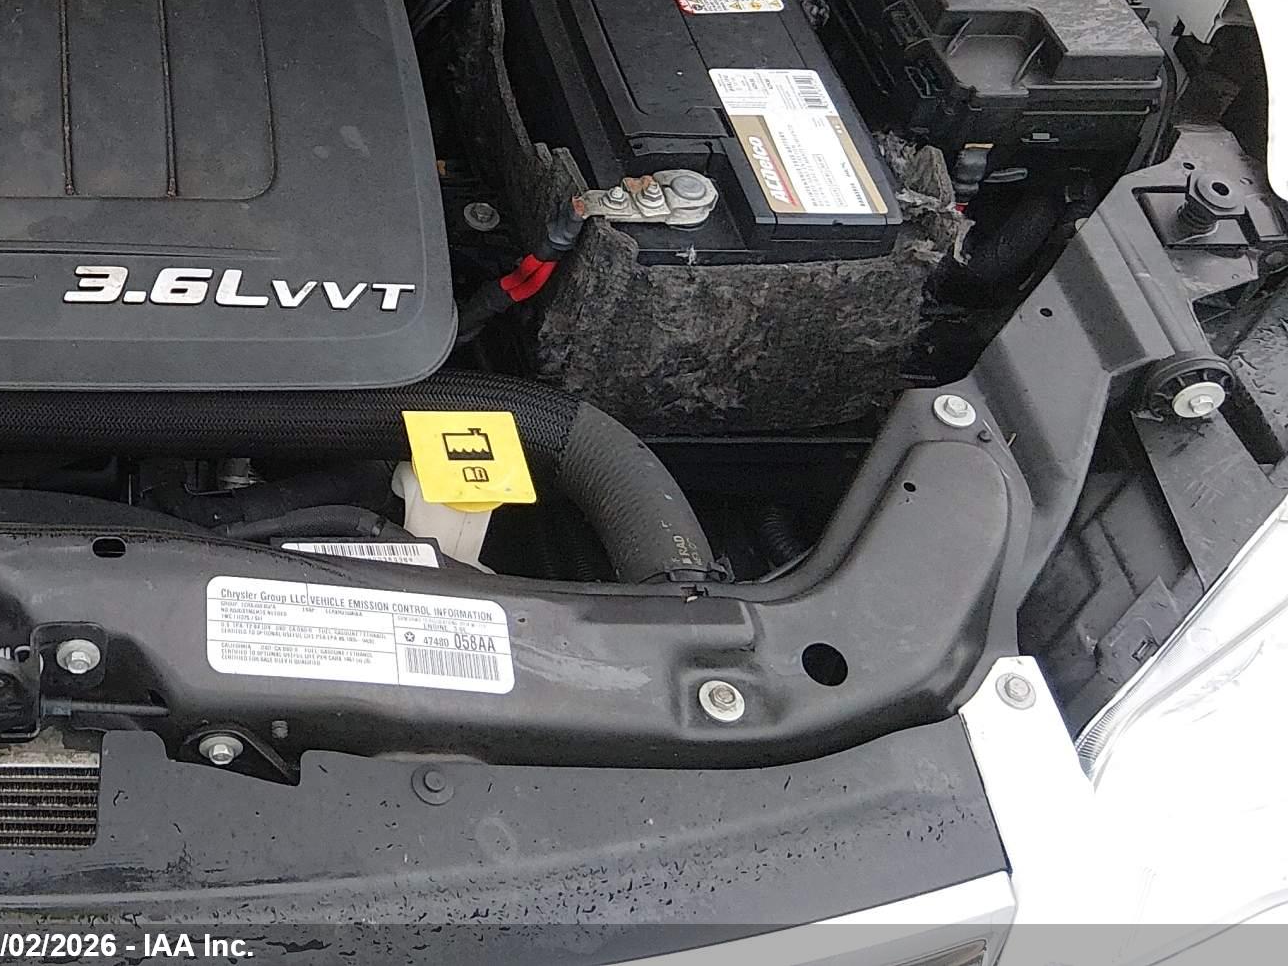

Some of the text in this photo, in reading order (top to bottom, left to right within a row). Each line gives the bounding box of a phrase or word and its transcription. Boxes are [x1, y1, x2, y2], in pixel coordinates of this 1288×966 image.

[220, 588, 493, 621] Chrysler Group LLC VEHICLE EMISSION CONTROL INFORMATION
[423, 633, 497, 652] 47480 058AA
